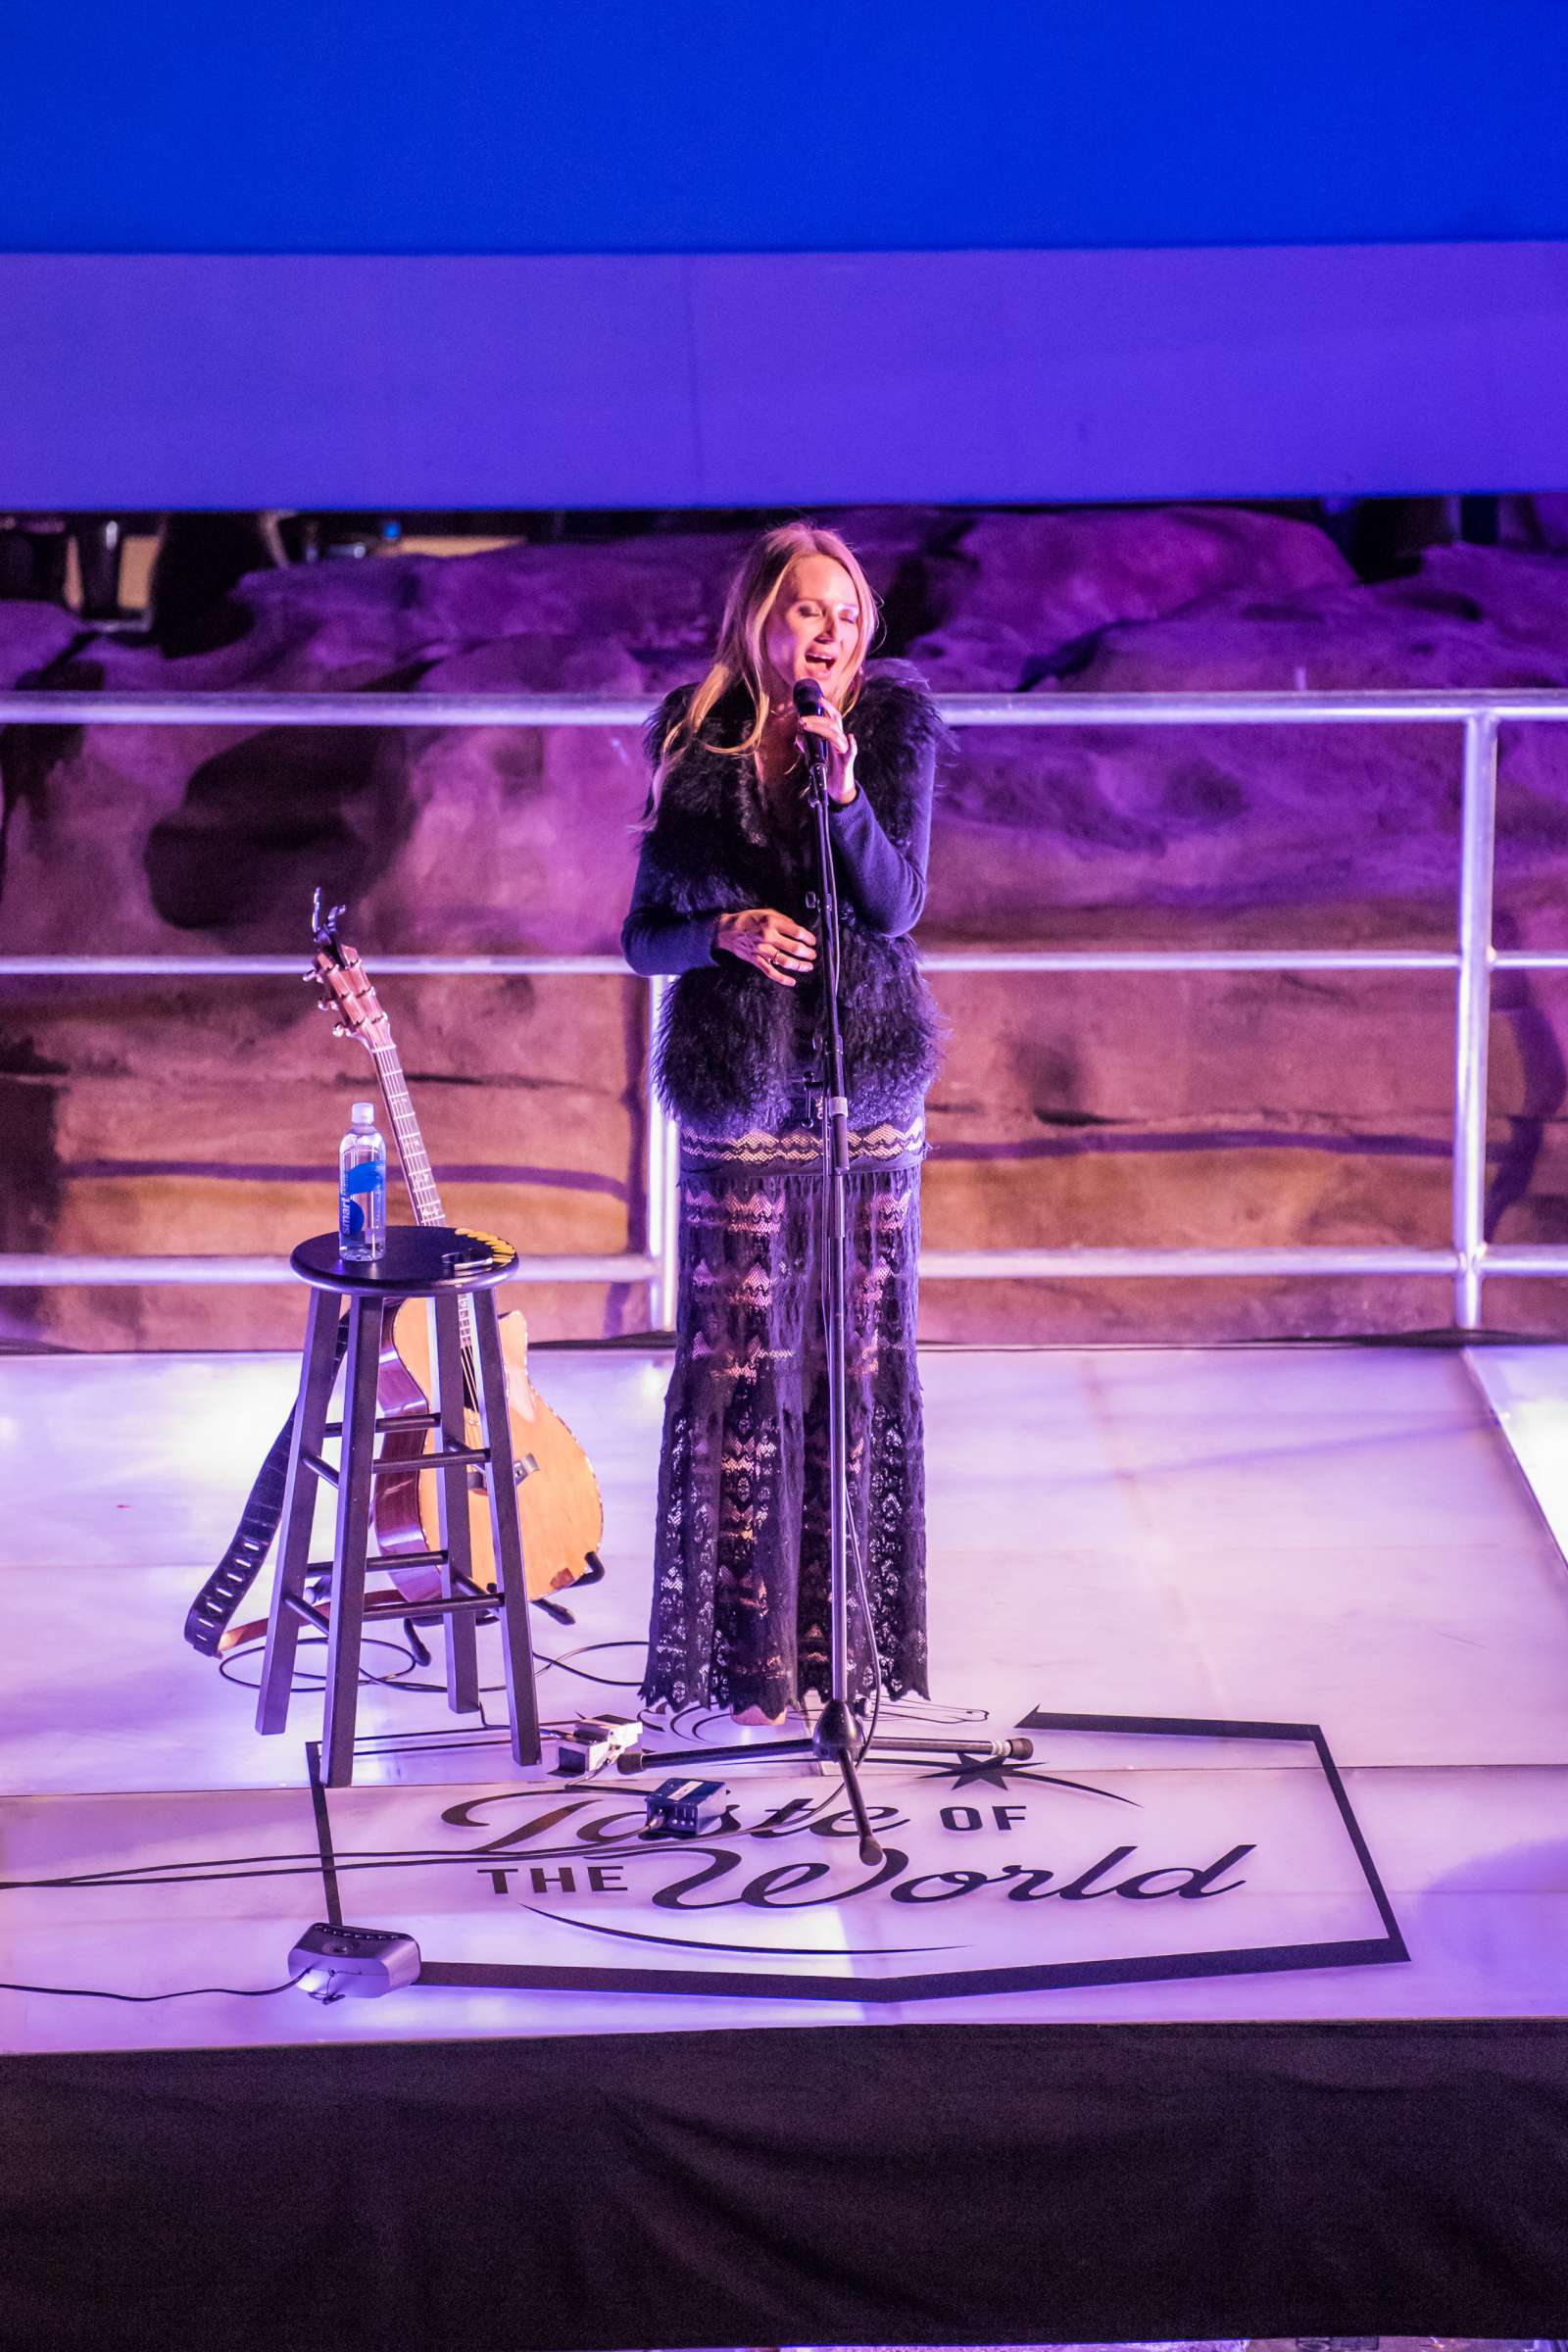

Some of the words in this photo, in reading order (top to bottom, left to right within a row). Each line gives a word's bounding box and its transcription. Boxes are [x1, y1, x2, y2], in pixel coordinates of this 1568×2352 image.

[940, 1805, 1027, 1832] OF
[477, 1866, 628, 1894] THE
[582, 1844, 1256, 1909] World
